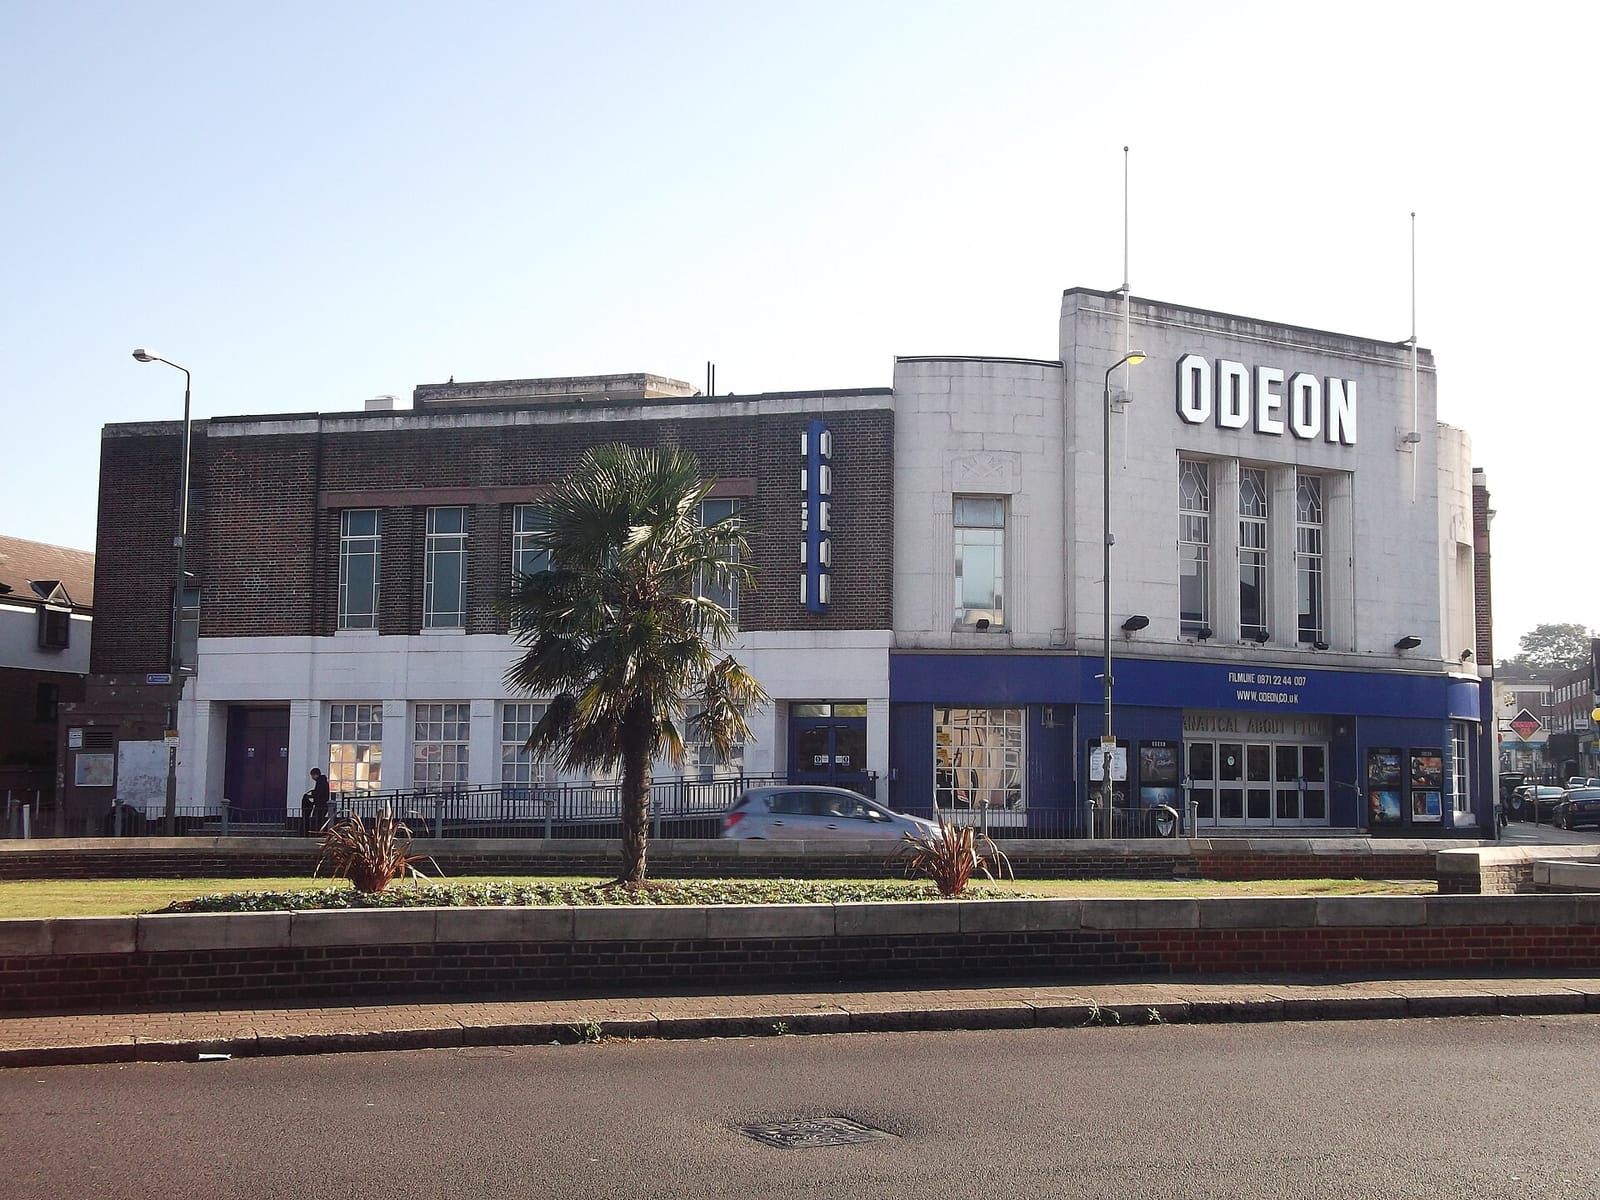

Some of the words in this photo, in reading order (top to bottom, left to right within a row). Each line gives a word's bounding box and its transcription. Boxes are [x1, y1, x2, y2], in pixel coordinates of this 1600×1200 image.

[1176, 353, 1357, 446] ODEON
[1228, 672, 1256, 683] FILMLINE
[1273, 675, 1282, 686] 22
[1282, 676, 1292, 686] 44
[1294, 676, 1307, 687] 007
[1246, 718, 1286, 735] ABOUT
